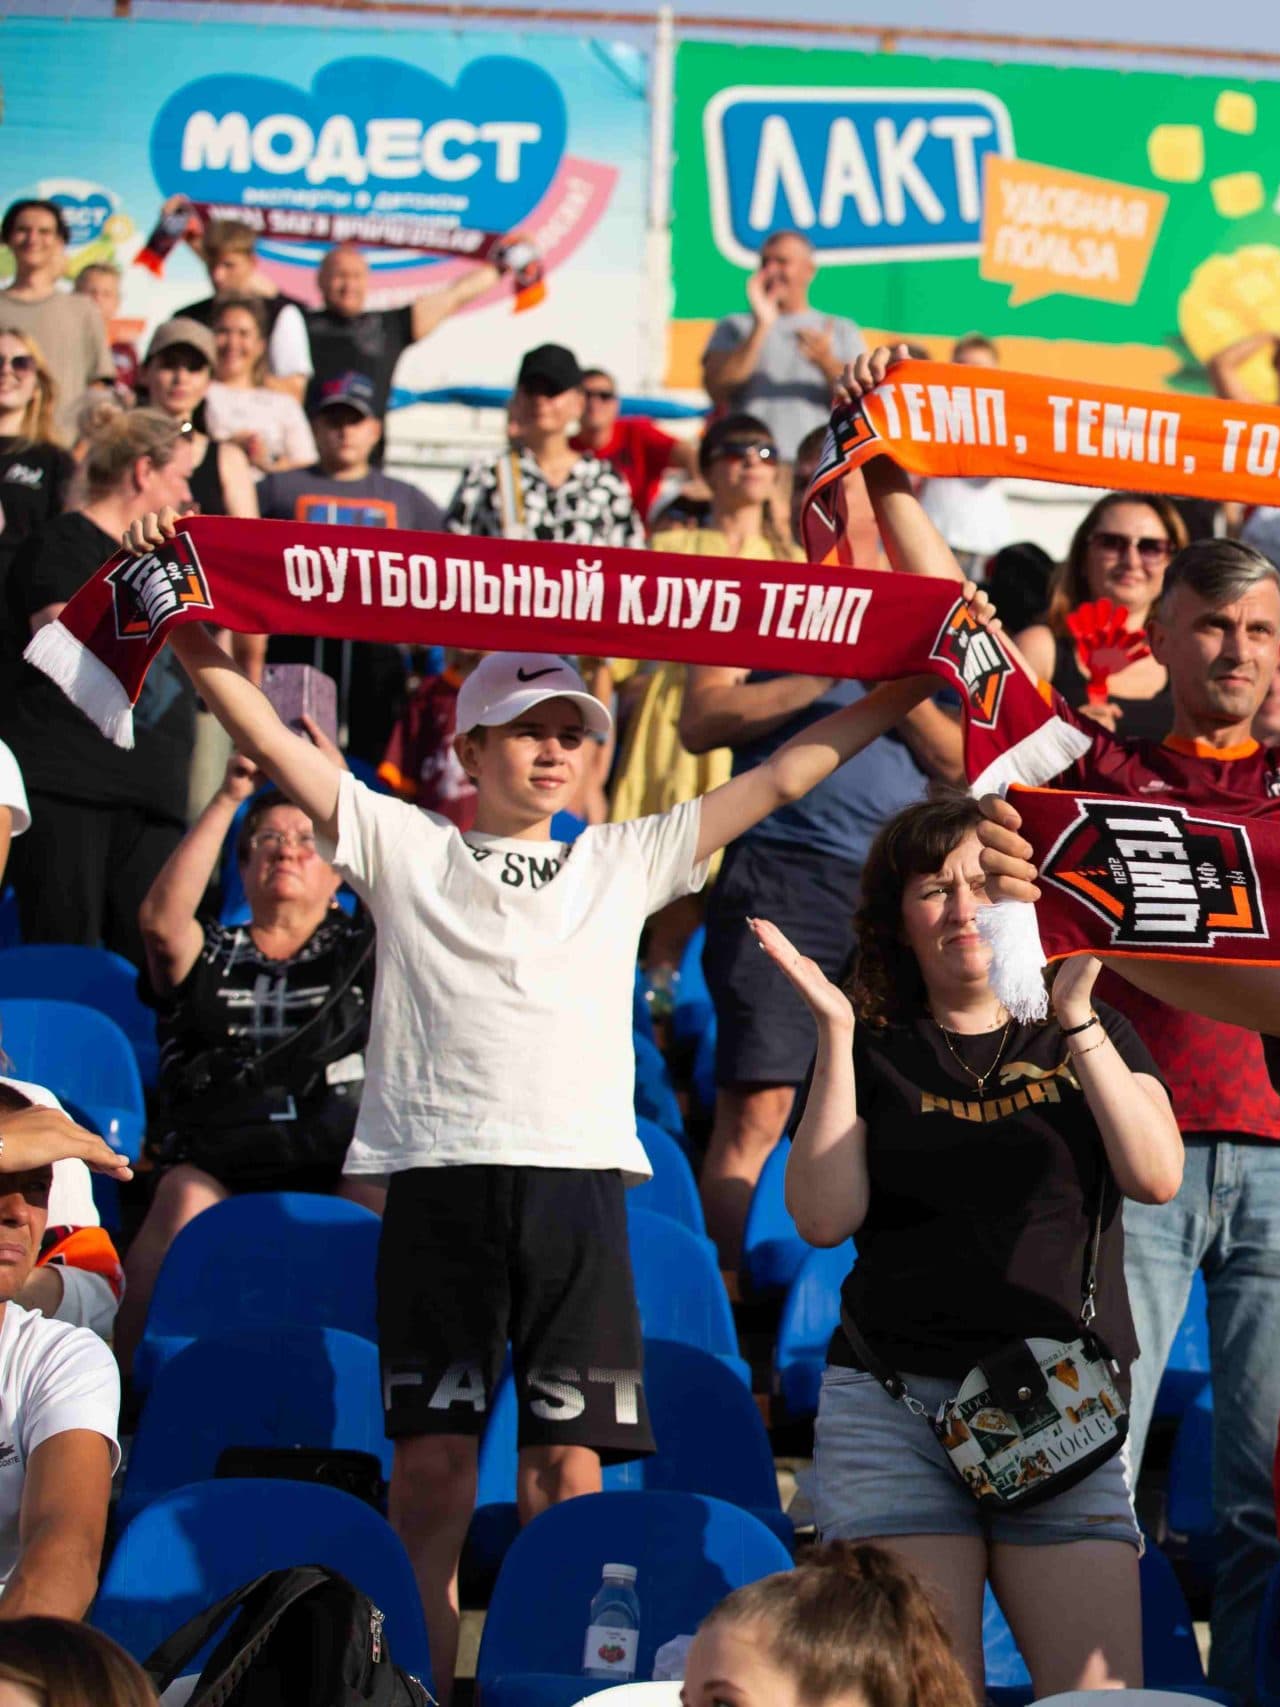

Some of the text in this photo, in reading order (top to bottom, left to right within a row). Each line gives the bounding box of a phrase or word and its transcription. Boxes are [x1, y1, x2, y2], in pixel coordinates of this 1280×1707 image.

[181, 110, 541, 185] МОДЕСТ
[749, 114, 993, 229] ЛАКТ
[874, 383, 1027, 454] ТЕМП,
[1048, 395, 1196, 475] ТЕМП,
[283, 544, 873, 645] ФУТБОЛЬНЫЙ КЛУБ ТЕМП
[1105, 816, 1200, 932] ТЕМП
[1108, 857, 1128, 885] 2020
[1196, 862, 1221, 889] ФК
[921, 1079, 1061, 1122] PUMA
[1048, 1414, 1113, 1463] VOGUE
